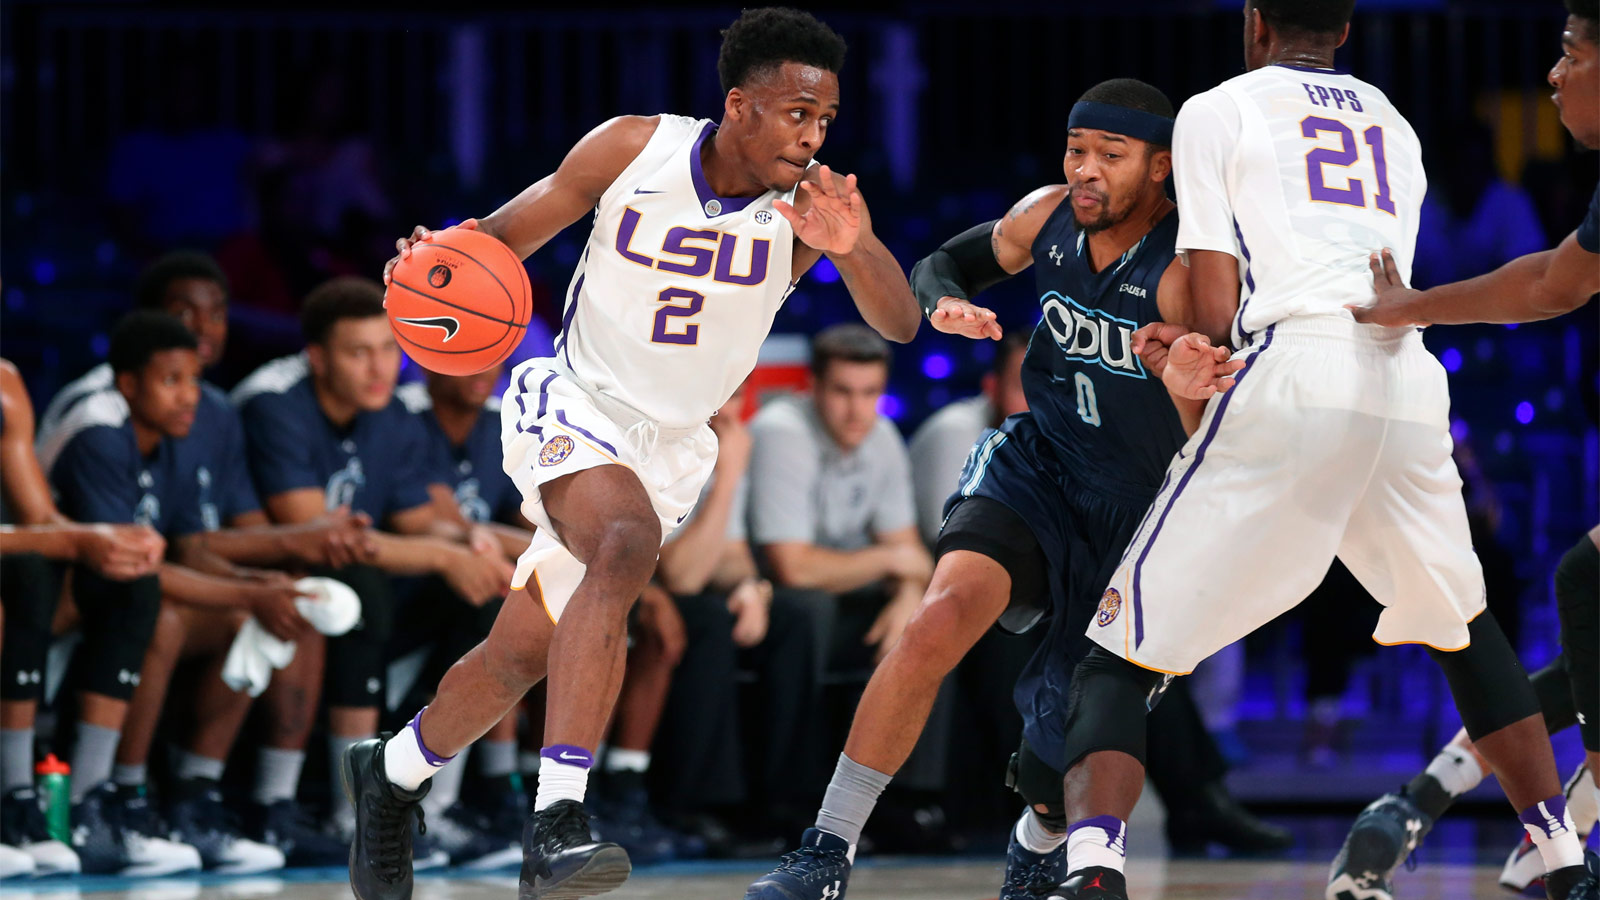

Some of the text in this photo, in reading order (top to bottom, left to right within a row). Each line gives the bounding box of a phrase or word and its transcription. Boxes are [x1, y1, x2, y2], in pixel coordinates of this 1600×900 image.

[1301, 83, 1363, 113] EPPS
[1299, 114, 1397, 218] 21
[615, 205, 772, 287] LSU
[755, 210, 772, 225] SEC
[650, 286, 706, 345] 2
[1042, 298, 1137, 371] ODU
[1074, 371, 1101, 428] 0
